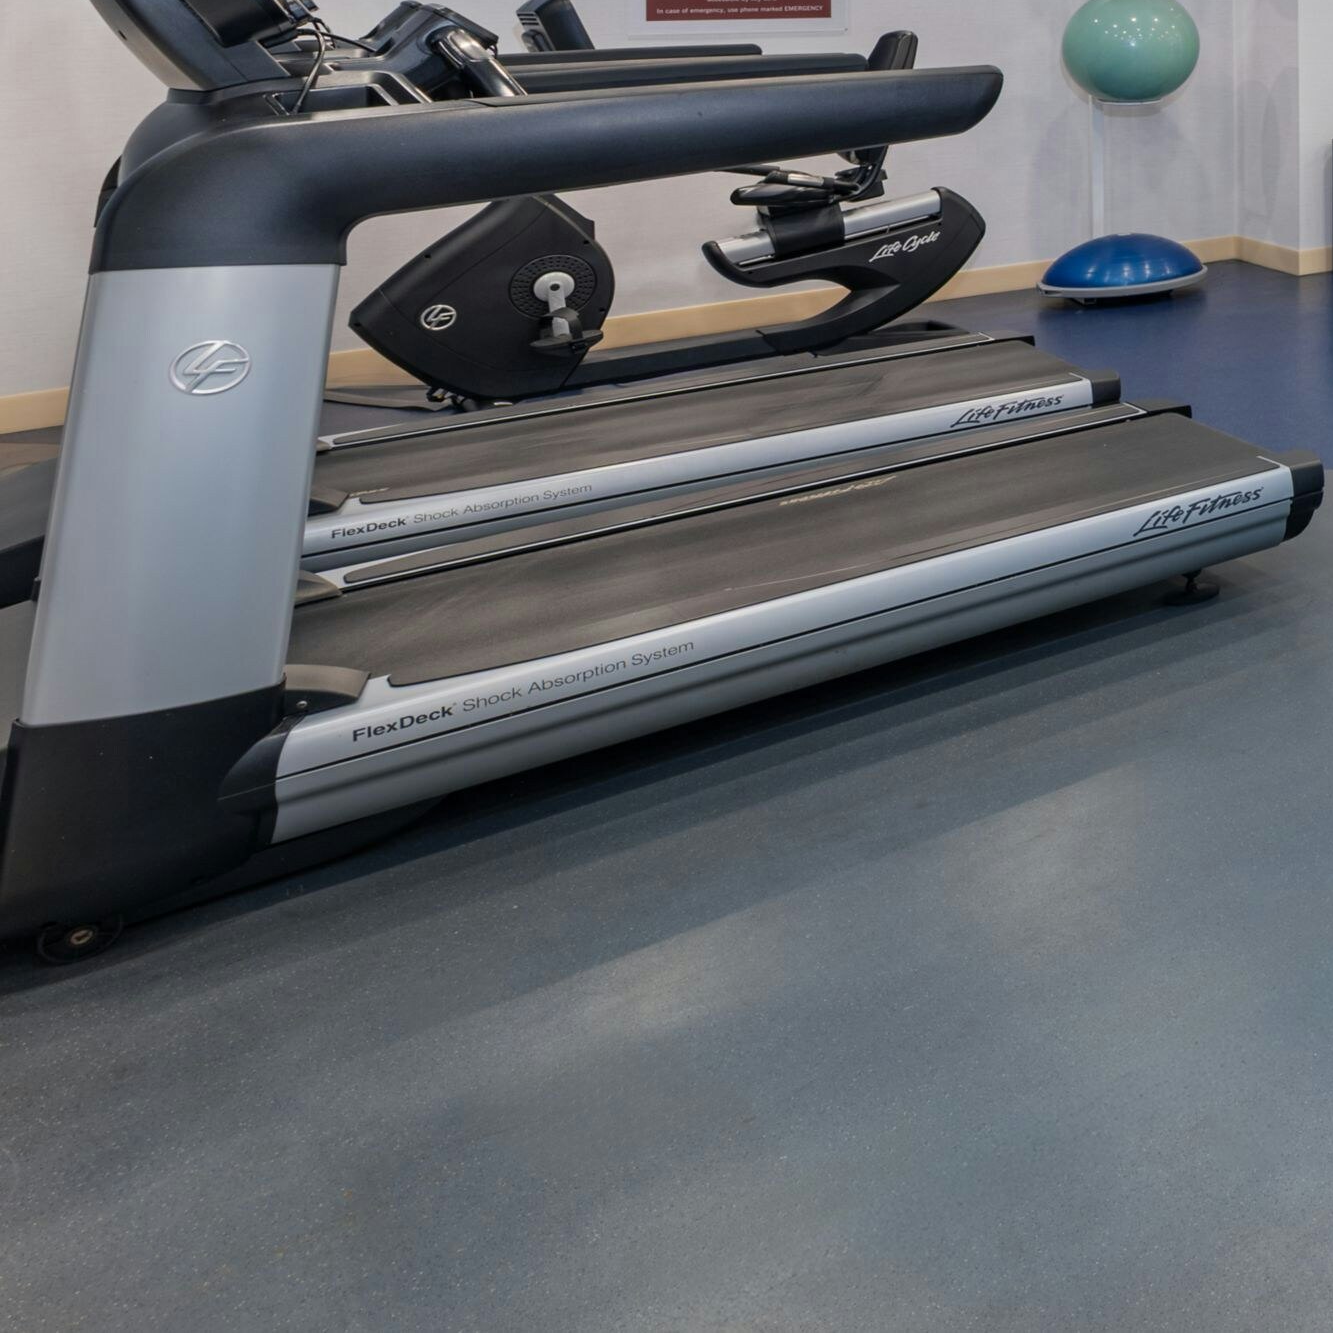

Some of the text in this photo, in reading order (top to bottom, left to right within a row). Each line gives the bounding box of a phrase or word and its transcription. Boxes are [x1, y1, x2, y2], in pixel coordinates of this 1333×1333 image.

[740, 6, 759, 14] phone
[868, 231, 941, 263] Life Cycle
[330, 484, 593, 539] FlexDeck Shock Absorption System
[352, 640, 695, 743] FlexDeck Shock Absorption System
